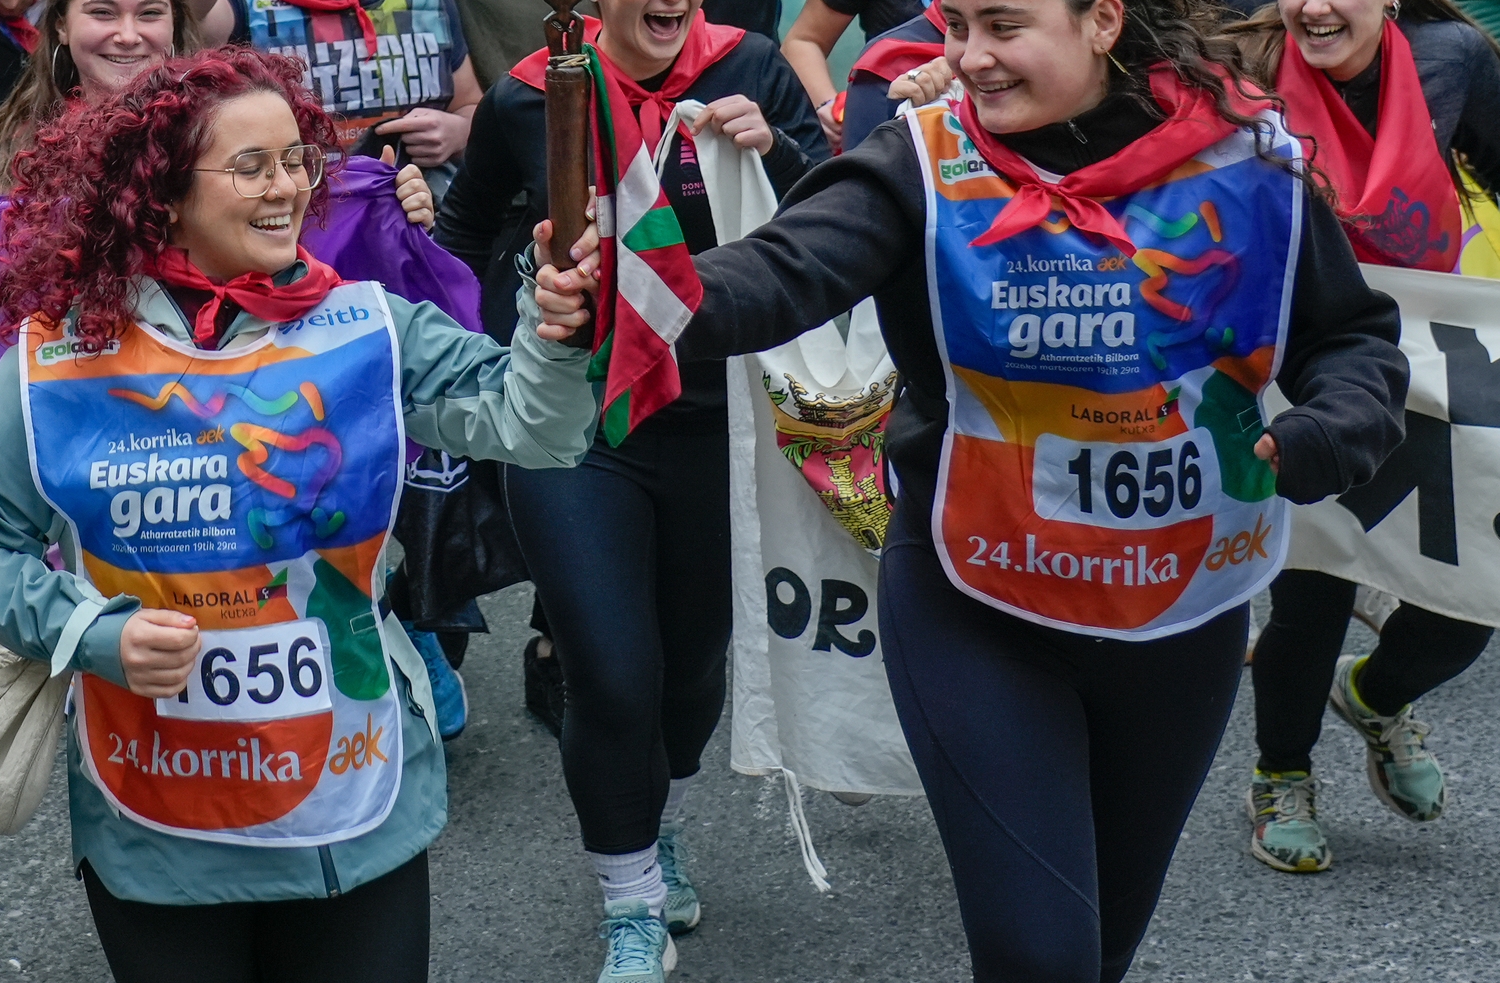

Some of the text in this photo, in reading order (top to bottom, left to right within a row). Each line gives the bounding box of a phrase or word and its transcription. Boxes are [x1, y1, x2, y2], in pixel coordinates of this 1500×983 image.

[941, 159, 993, 179] goien
[1006, 253, 1127, 274] 24.korrika aek
[991, 276, 1131, 310] Euskara
[307, 305, 370, 327] eitb
[1008, 311, 1136, 359] gara
[1005, 361, 1140, 376] 2026ko martxoaren 19tik 29ra
[1040, 353, 1139, 363] Atharratzetik Bilbora
[1071, 404, 1154, 425] LABORAL
[108, 423, 226, 454] 24.korrika aek
[1120, 423, 1155, 436] kutxa
[90, 452, 228, 488] Euskara
[1068, 440, 1202, 519] 1656
[110, 483, 232, 538] gara
[140, 525, 236, 540] Atharratzetik Bilbora
[140, 543, 190, 553] martxoaren
[193, 541, 215, 552] 19tik
[217, 541, 237, 551] 29ra
[966, 512, 1272, 587] 24.korrika aek
[173, 589, 254, 608] LABORAL
[220, 608, 256, 620] kutxa
[177, 636, 322, 707] 656
[106, 712, 388, 783] 24.korrika aek
